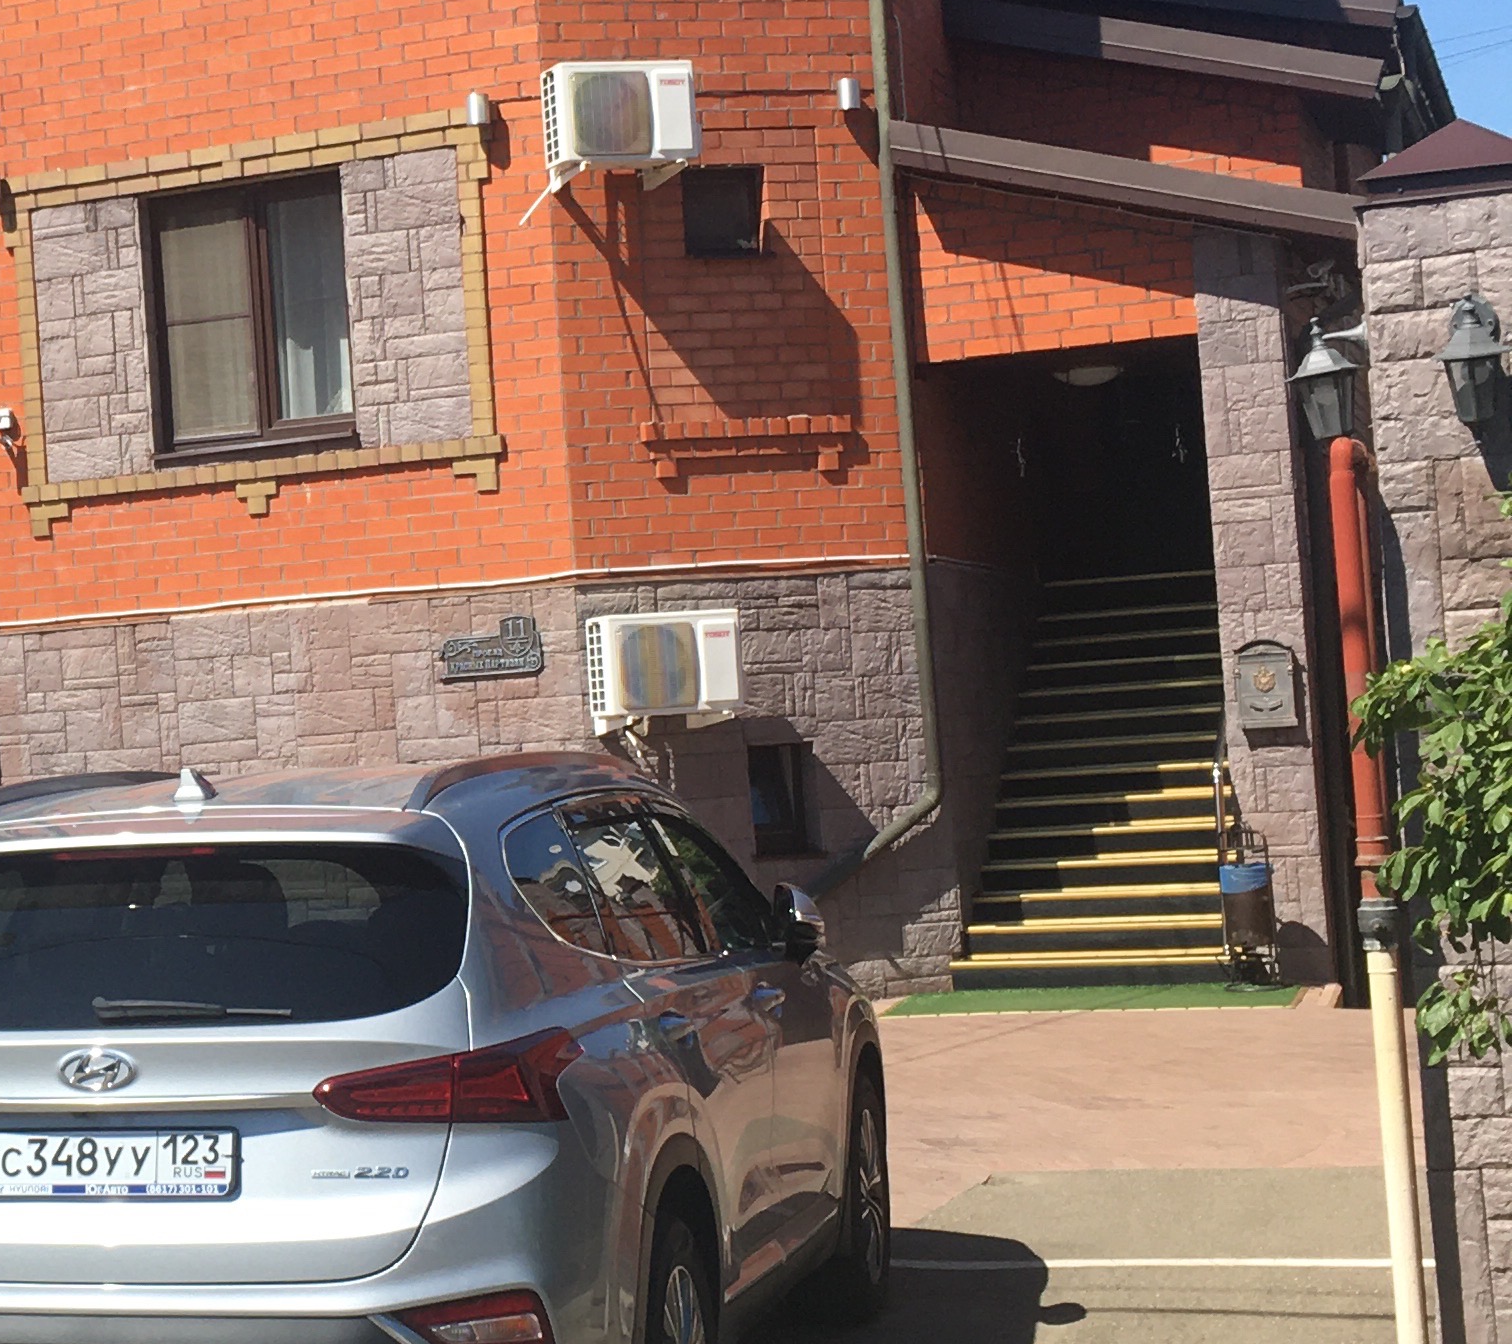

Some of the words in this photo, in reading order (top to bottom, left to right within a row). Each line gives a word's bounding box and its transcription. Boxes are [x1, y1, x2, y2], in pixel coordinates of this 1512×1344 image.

[504, 619, 525, 639] 11
[162, 1134, 219, 1165] 123
[173, 1167, 203, 1178] RUS
